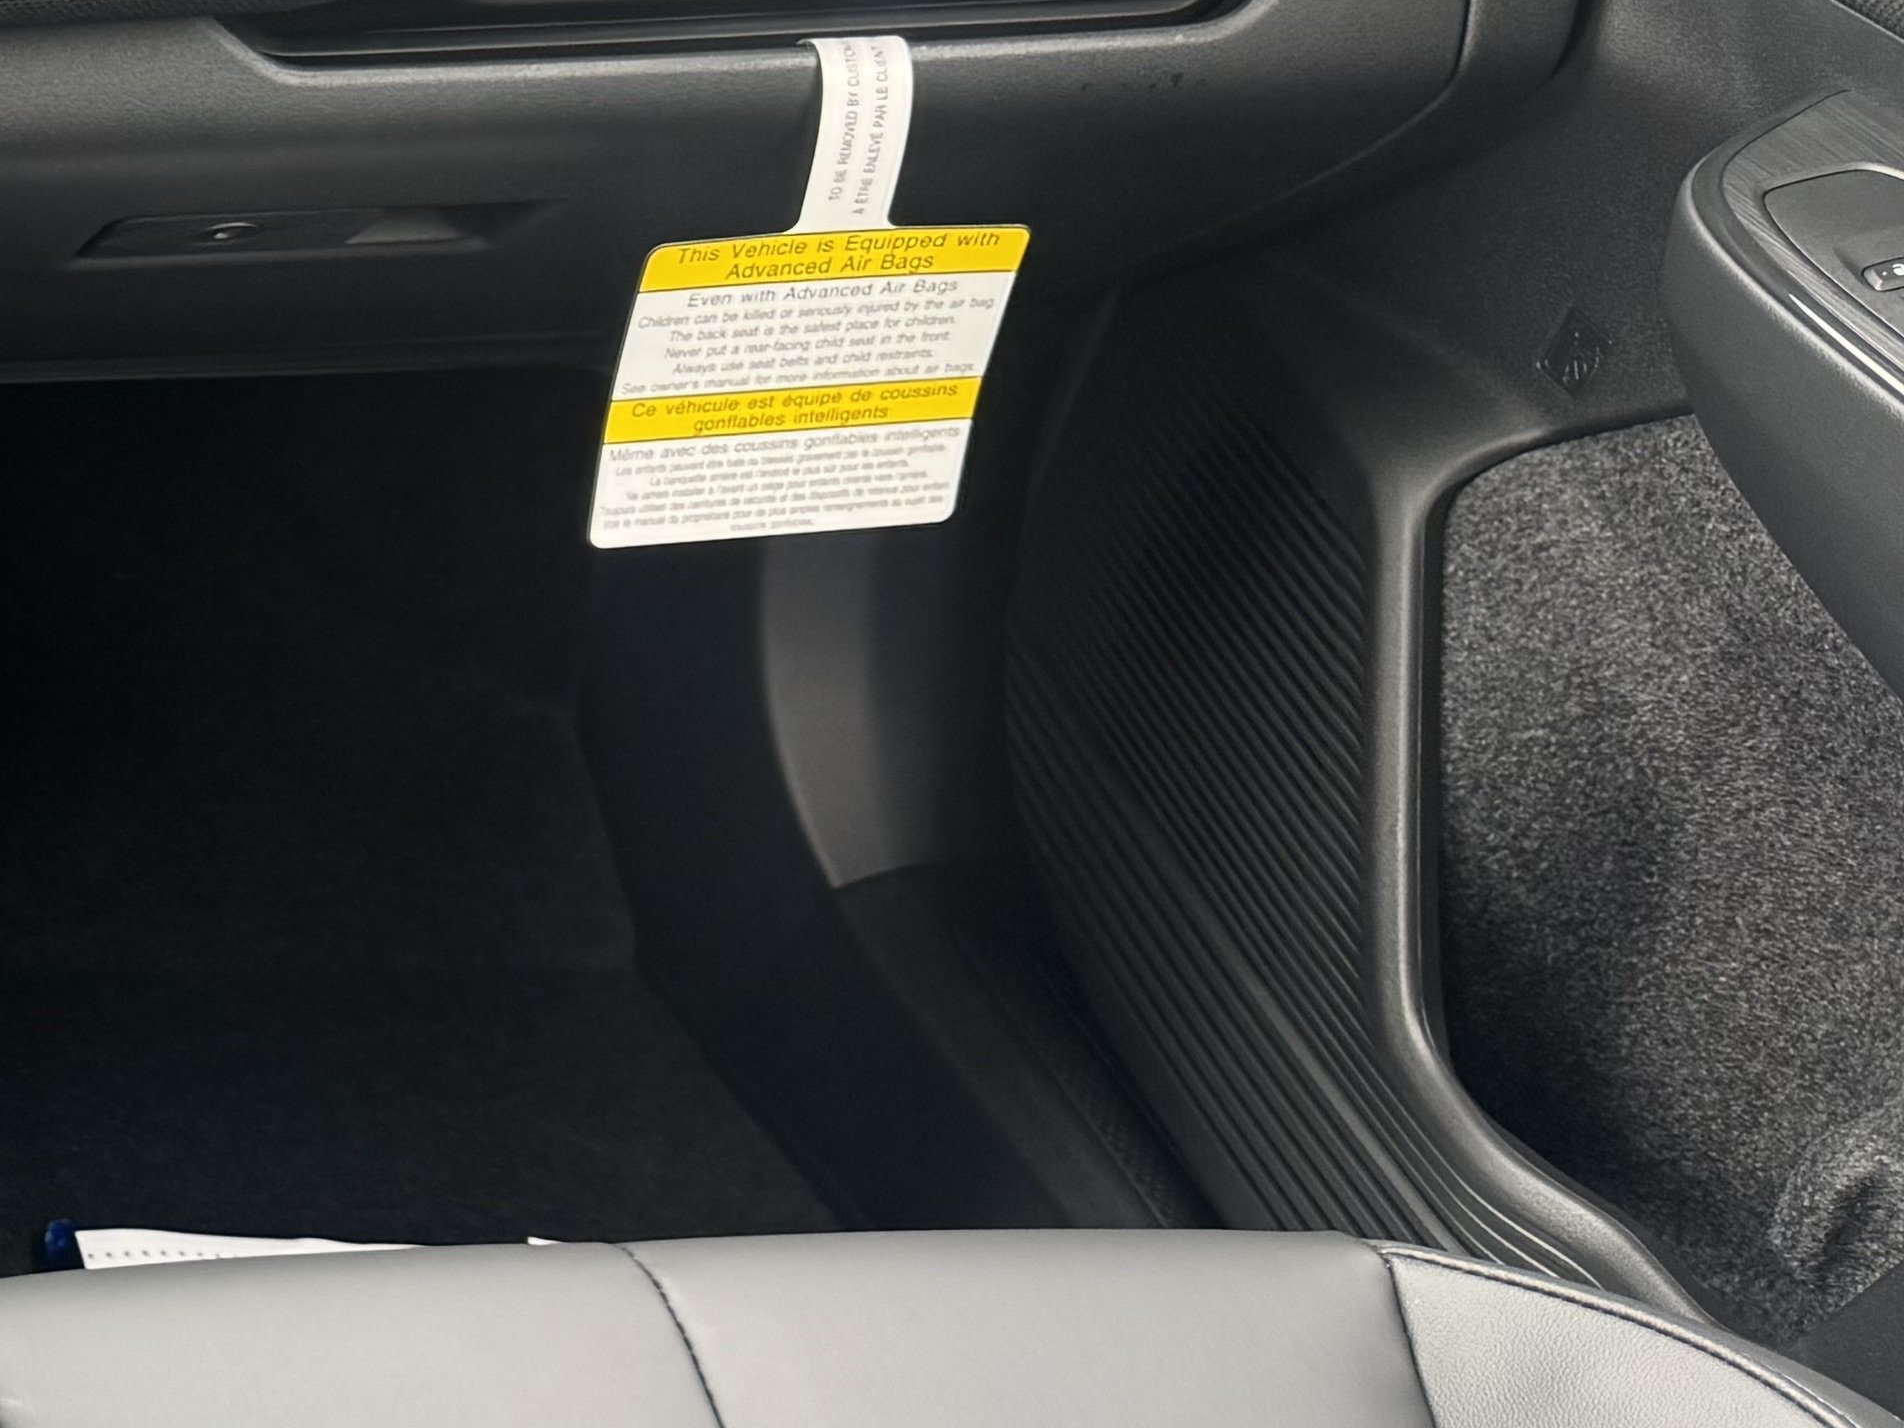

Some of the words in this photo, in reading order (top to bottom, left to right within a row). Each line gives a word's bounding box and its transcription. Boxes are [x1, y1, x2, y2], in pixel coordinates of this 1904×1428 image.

[677, 248, 720, 264] This
[732, 239, 807, 259] Vehicle
[817, 239, 834, 253] is
[845, 233, 947, 253] Equipped
[957, 232, 1000, 246] with
[726, 258, 831, 279] Advanced
[840, 255, 873, 272] Air
[881, 254, 934, 273] Bags
[687, 293, 732, 307] Even
[741, 289, 775, 302] with
[783, 284, 873, 300] Advanced
[880, 281, 906, 294] Air
[913, 279, 958, 295] Bags
[638, 315, 689, 329] Children
[694, 313, 717, 324] can
[722, 310, 739, 322] be
[743, 307, 775, 320] killed
[924, 299, 942, 309] the
[669, 330, 693, 342] The
[697, 328, 726, 340] back
[779, 323, 799, 335] the
[815, 335, 845, 349] child
[897, 331, 915, 342] the
[631, 403, 657, 418] Ce
[666, 397, 740, 416] véhicule
[747, 395, 775, 410] est
[850, 389, 873, 402] de
[880, 384, 958, 401] coussins
[693, 414, 786, 436] gonflables
[794, 406, 889, 426] intelligents
[660, 446, 696, 458] avec
[701, 443, 728, 455] des
